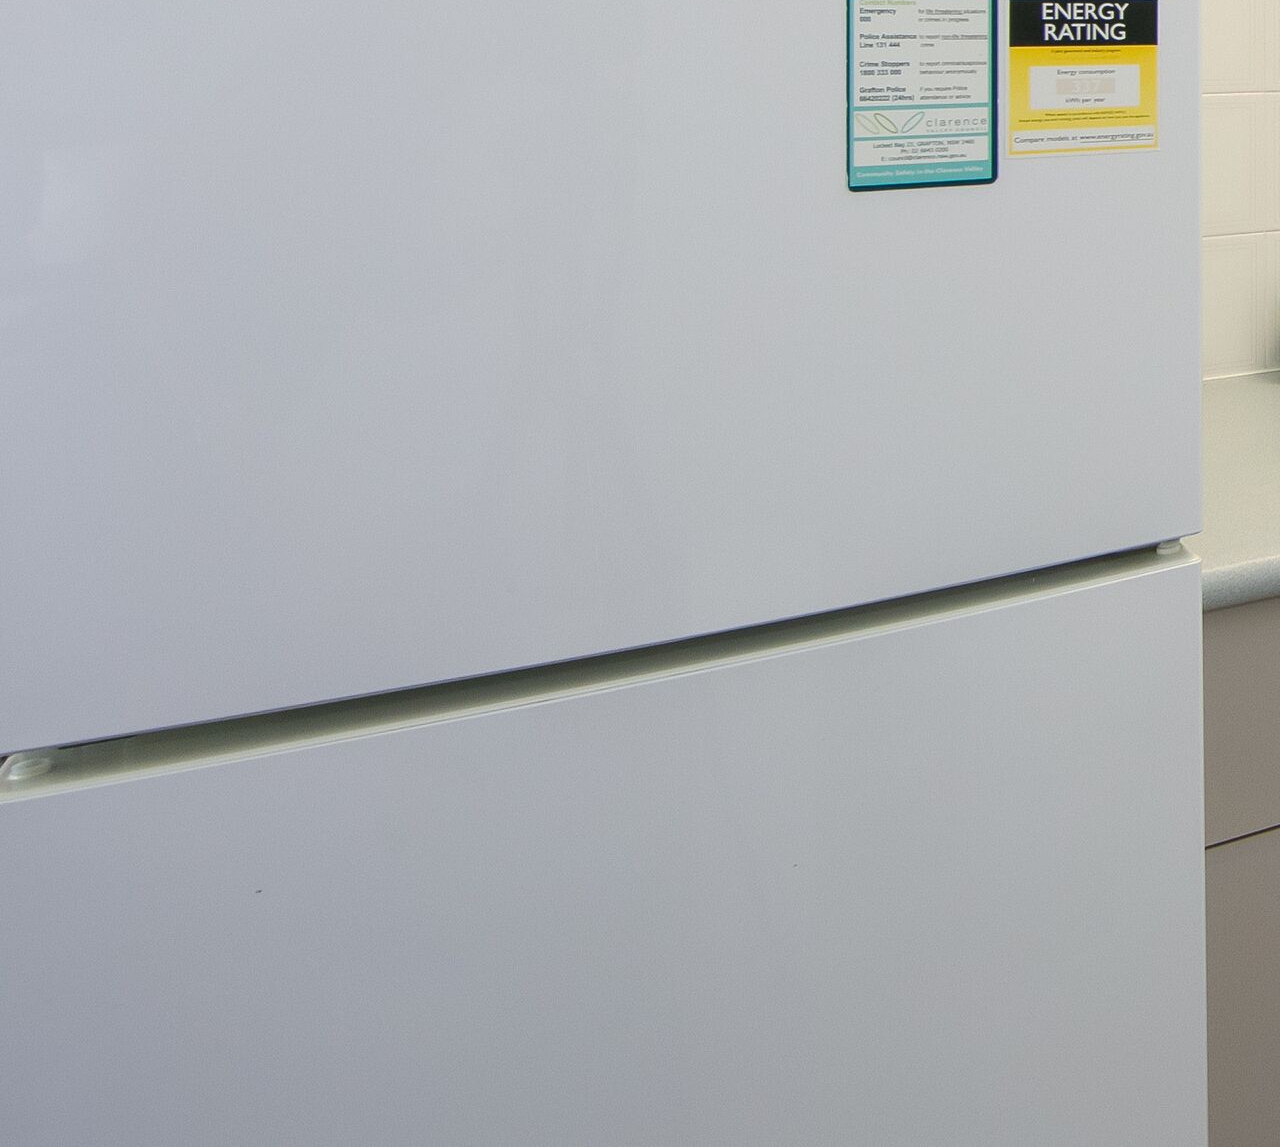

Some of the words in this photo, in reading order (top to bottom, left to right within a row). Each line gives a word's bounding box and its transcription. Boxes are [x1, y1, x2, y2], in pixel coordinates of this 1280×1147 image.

[1042, 2, 1129, 20] ENERGY
[1044, 23, 1126, 40] RATING
[926, 117, 987, 127] clarence
